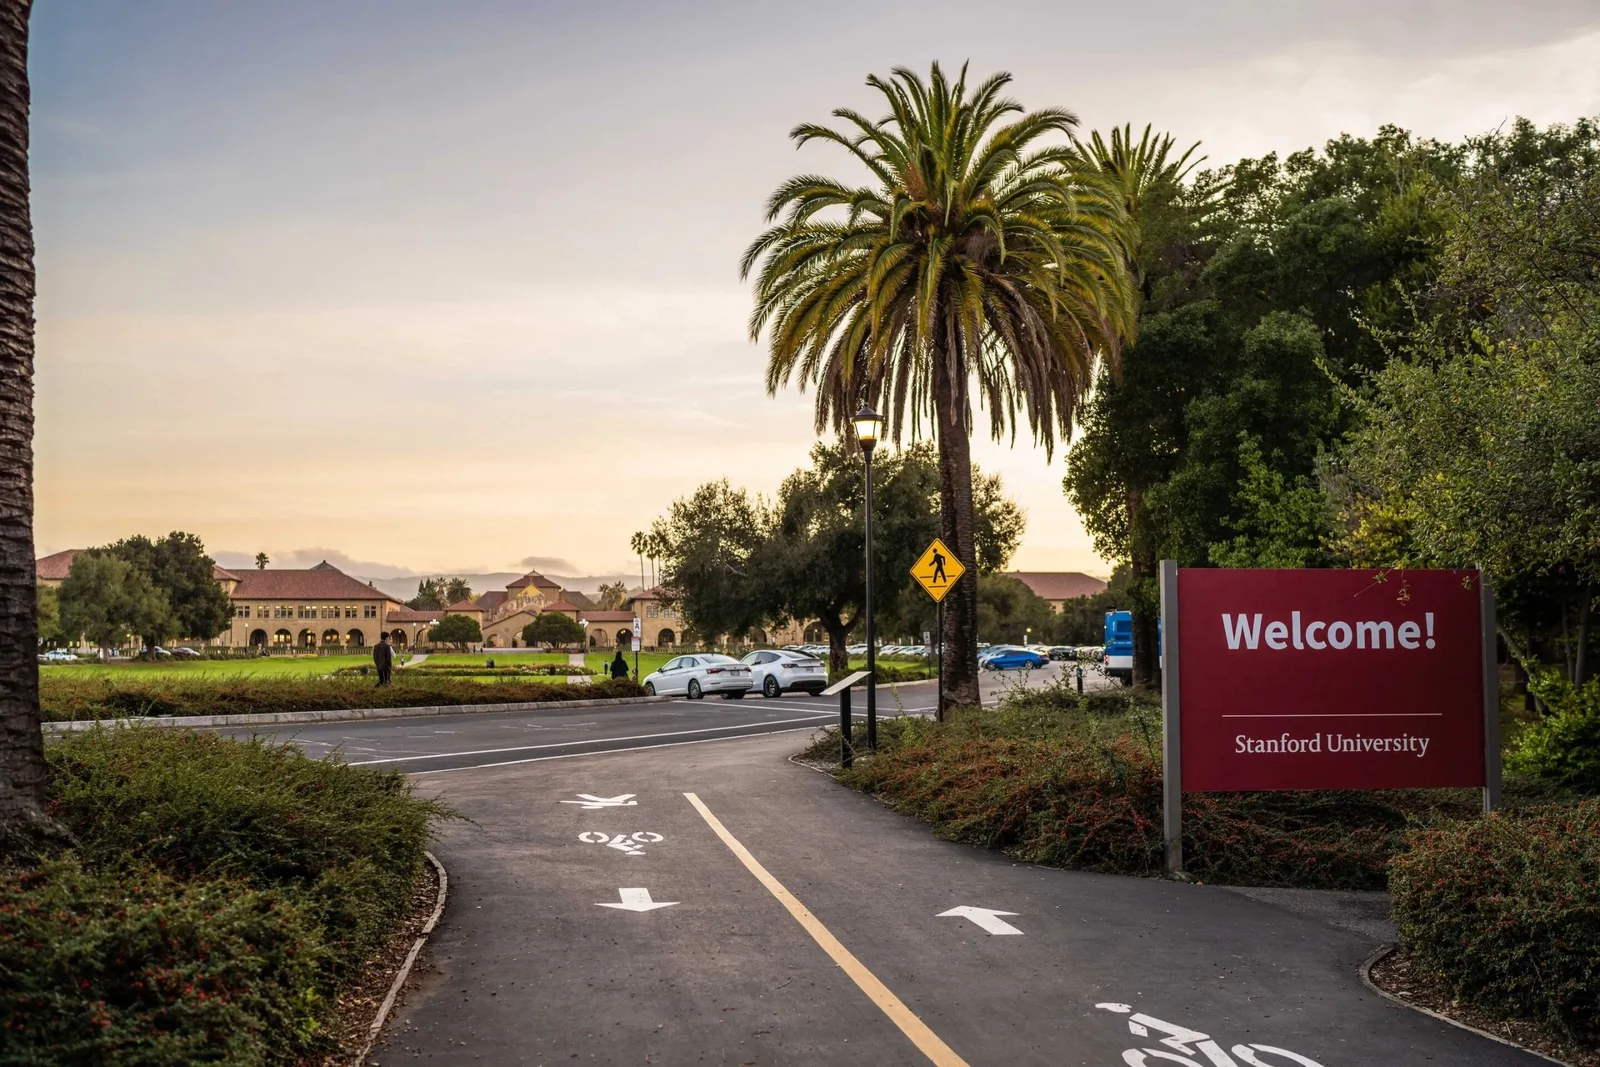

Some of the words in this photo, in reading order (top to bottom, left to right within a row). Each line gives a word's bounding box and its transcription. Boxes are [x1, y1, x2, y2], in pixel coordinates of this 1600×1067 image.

[1221, 610, 1436, 650] Welcome!
[1235, 732, 1321, 753] Stanford
[1326, 733, 1430, 758] University
